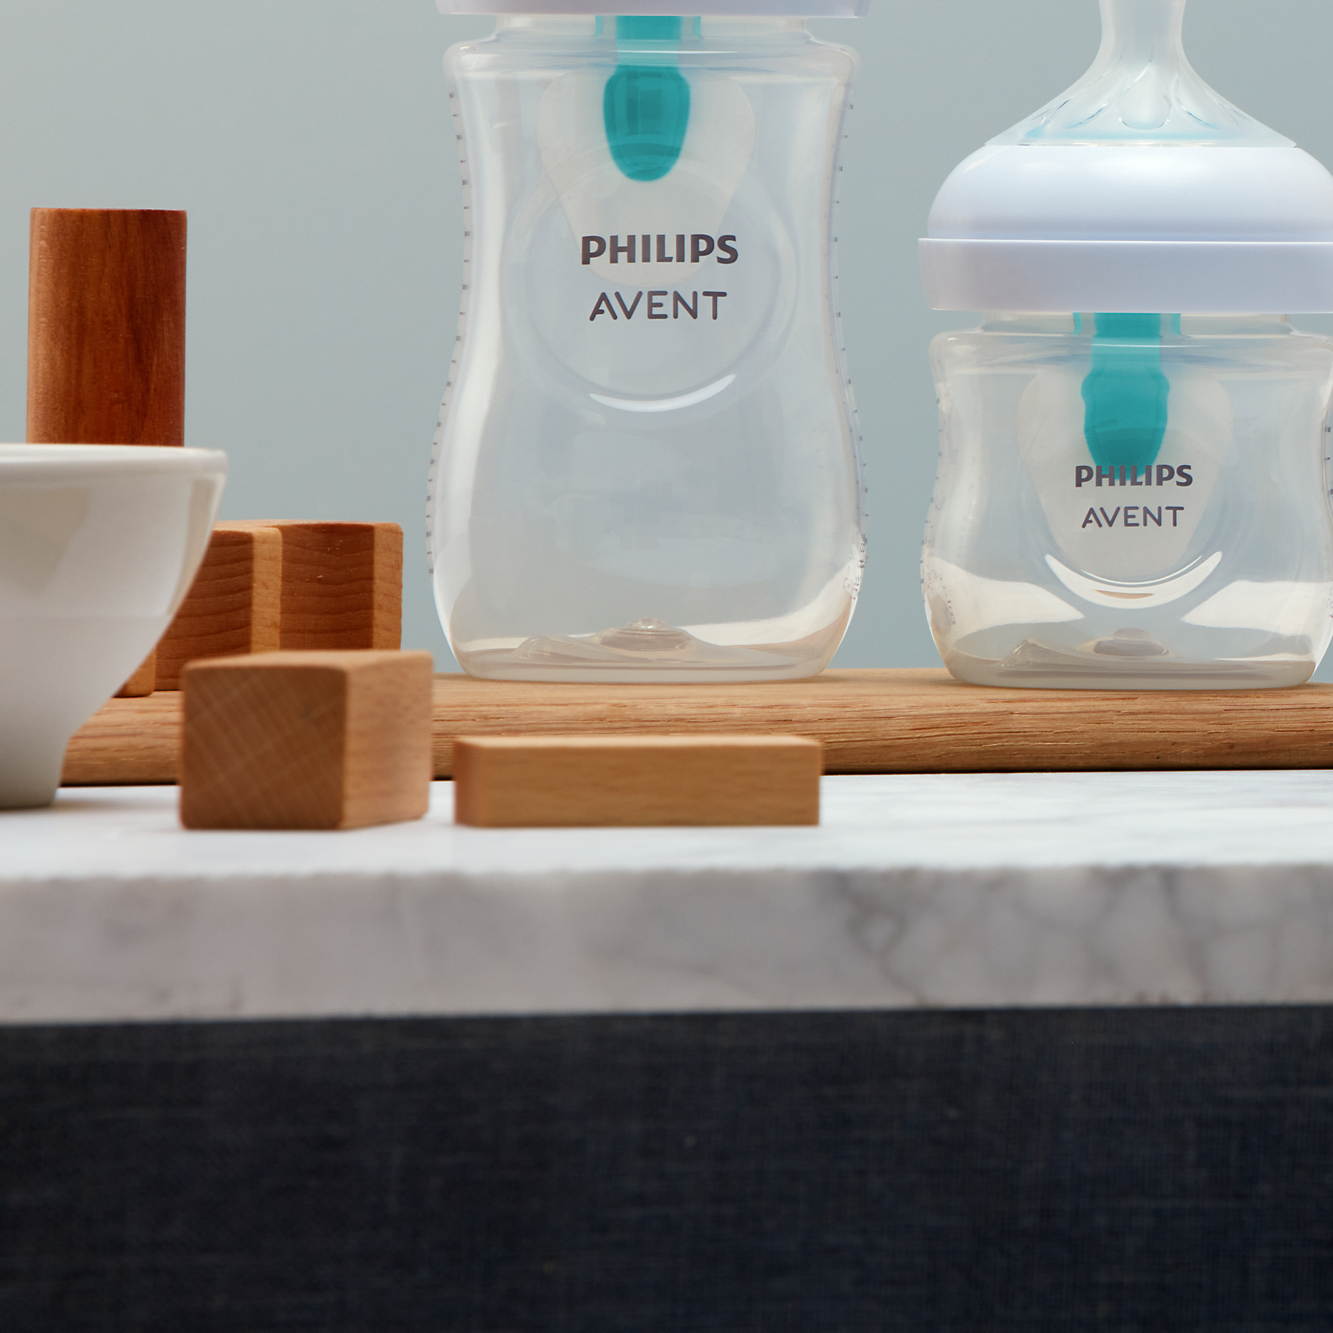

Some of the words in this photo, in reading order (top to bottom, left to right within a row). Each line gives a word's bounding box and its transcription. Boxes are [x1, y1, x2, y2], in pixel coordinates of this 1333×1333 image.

[581, 233, 738, 266] PHILIPS
[589, 289, 728, 322] AVENT
[1074, 463, 1194, 488] PHILIPS
[1080, 505, 1185, 529] AVENT
